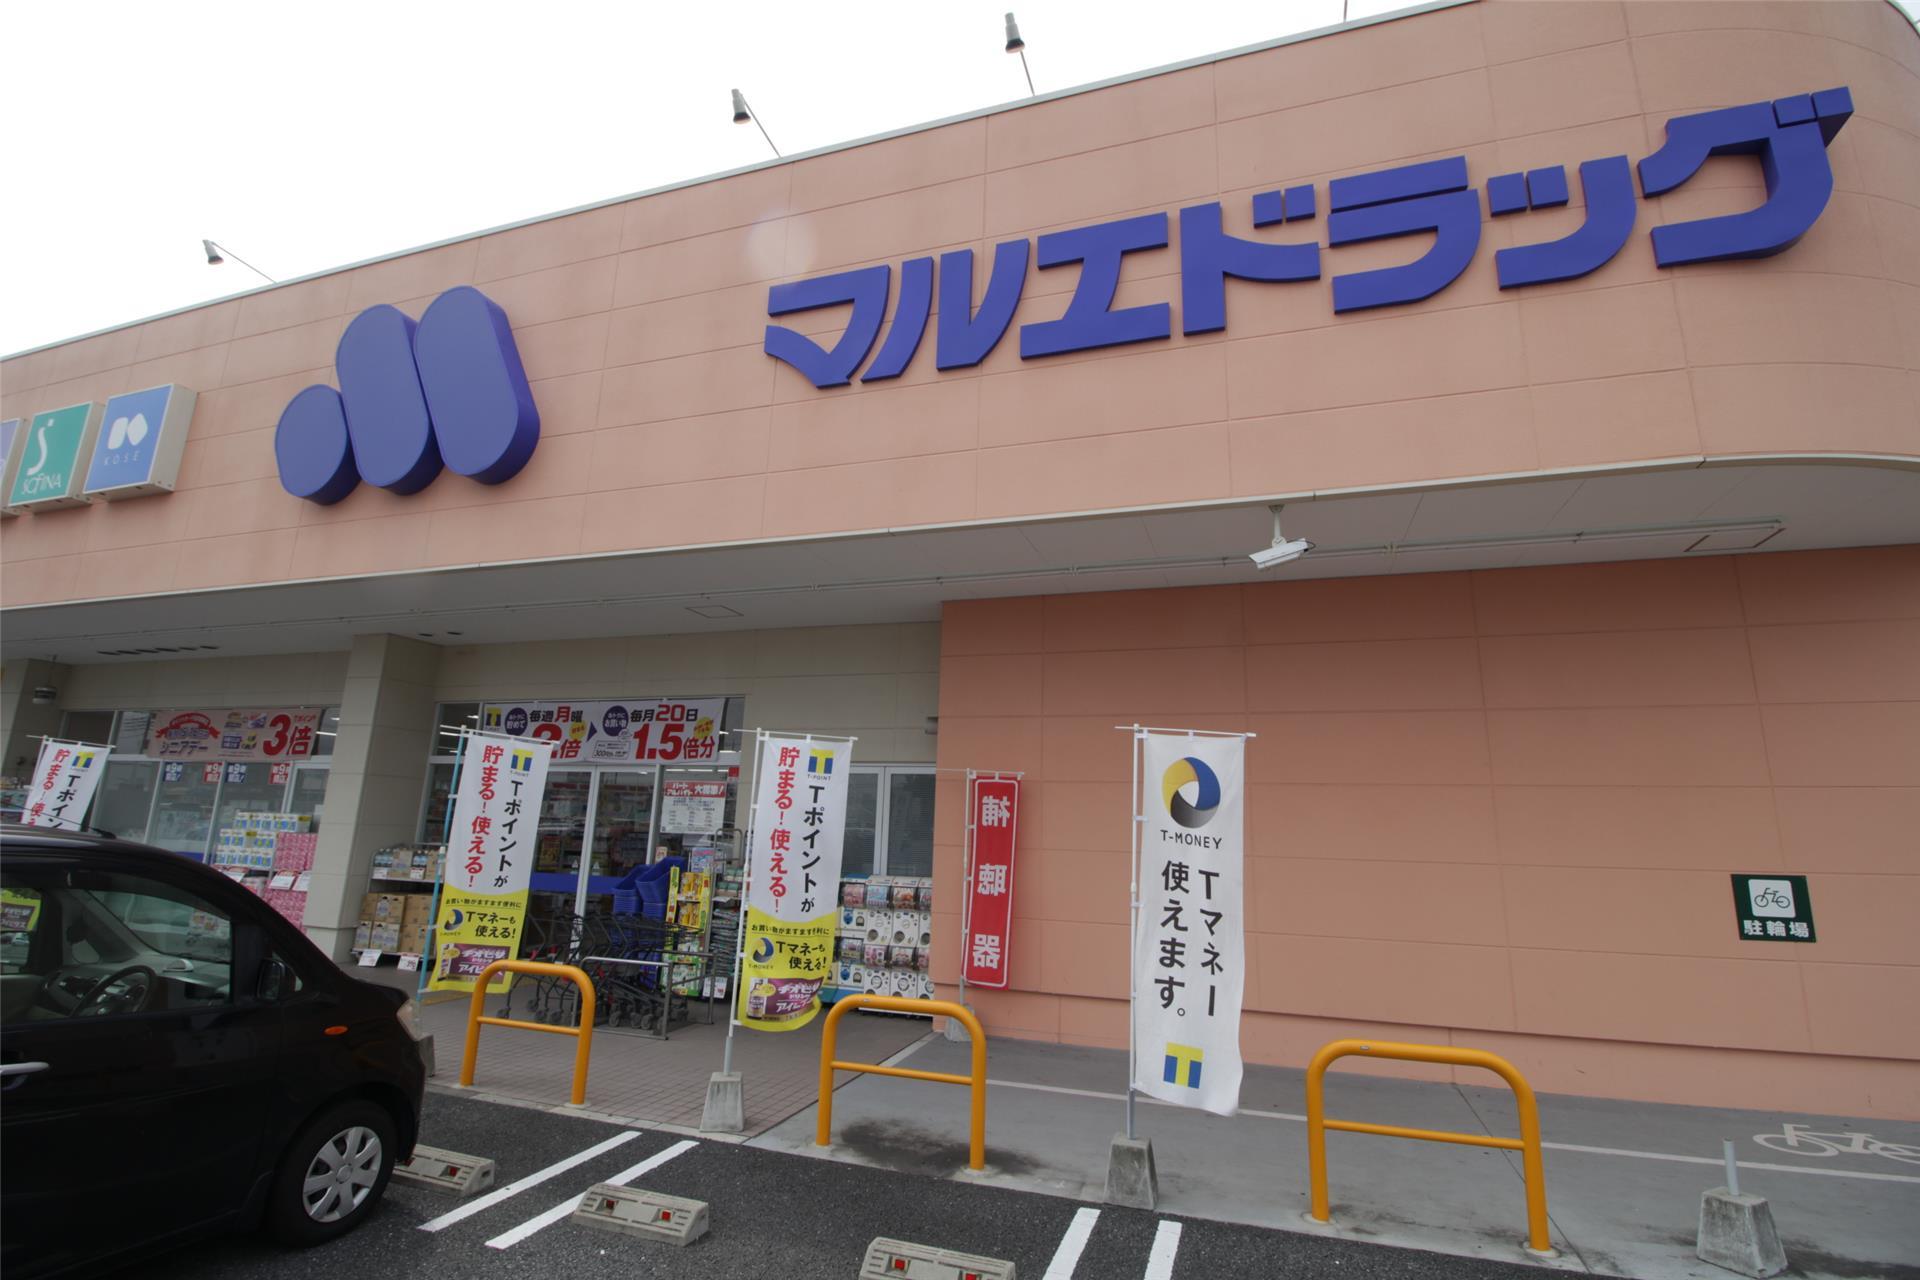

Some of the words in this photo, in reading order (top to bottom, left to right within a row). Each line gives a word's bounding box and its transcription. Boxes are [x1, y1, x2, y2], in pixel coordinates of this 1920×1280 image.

[764, 86, 1855, 389] マルエドラッグ
[530, 705, 584, 722] 毎週月曜
[630, 704, 698, 722] 毎月20日
[633, 723, 715, 760] 1.5倍分
[494, 780, 523, 888] Tポイントが
[1160, 829, 1223, 849] T-MONEY
[801, 785, 825, 913] Tポイントが
[466, 911, 516, 924] Tマネーも
[475, 925, 516, 939] 使える!
[1743, 919, 1810, 938] 駐輪場
[1154, 860, 1190, 1017] 使えます。
[1198, 868, 1224, 1017] Tマネー
[776, 941, 826, 956] Tマネーも
[789, 957, 827, 971] 使える!
